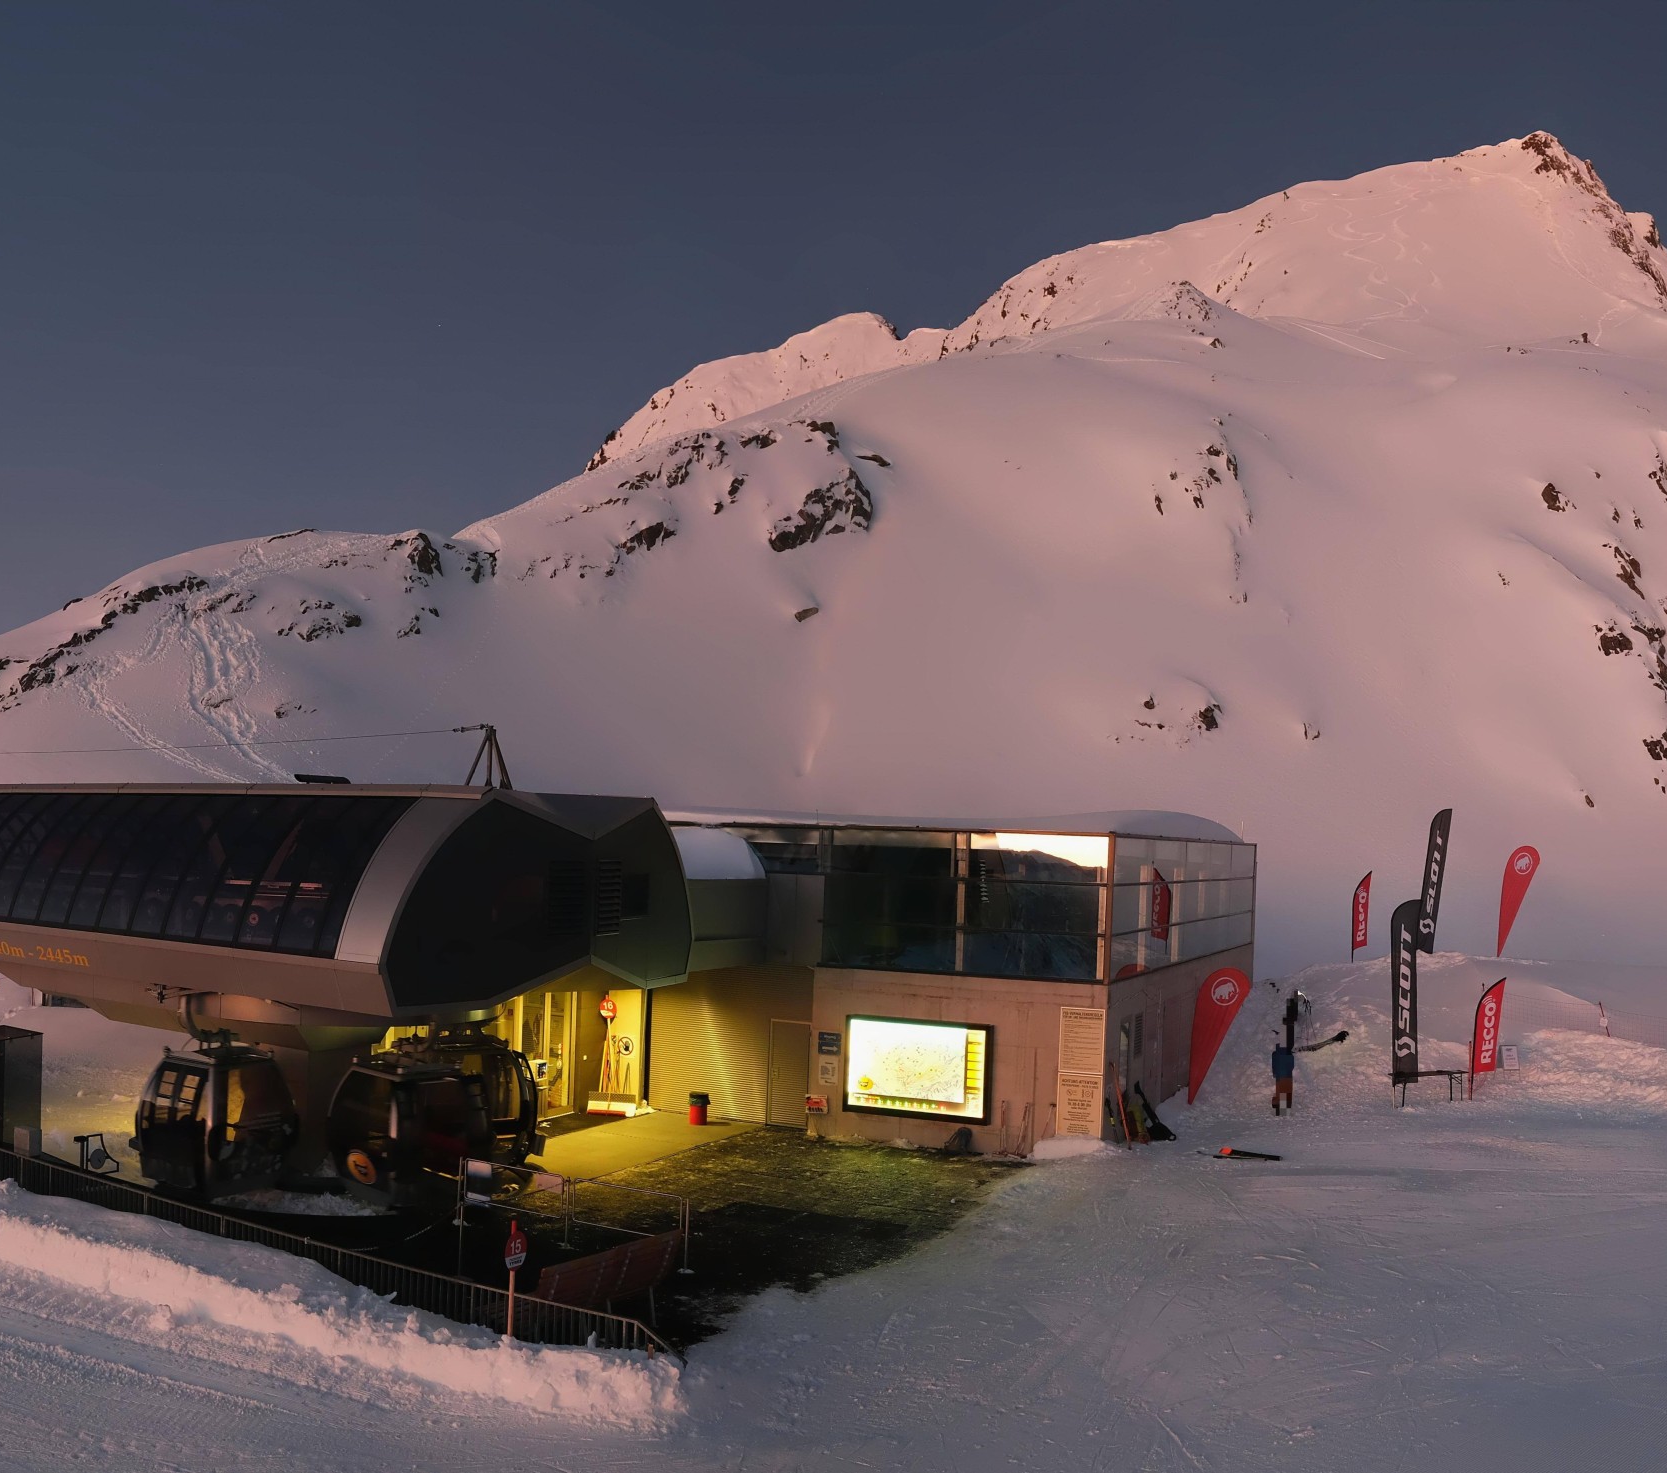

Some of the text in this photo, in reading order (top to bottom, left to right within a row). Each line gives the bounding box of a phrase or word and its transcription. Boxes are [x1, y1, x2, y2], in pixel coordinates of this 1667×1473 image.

[36, 946, 90, 967] 2445m
[1398, 924, 1413, 1034] SCOTT
[603, 1001, 614, 1010] 16
[1480, 1002, 1496, 1064] RECCO
[510, 1239, 522, 1255] 15
